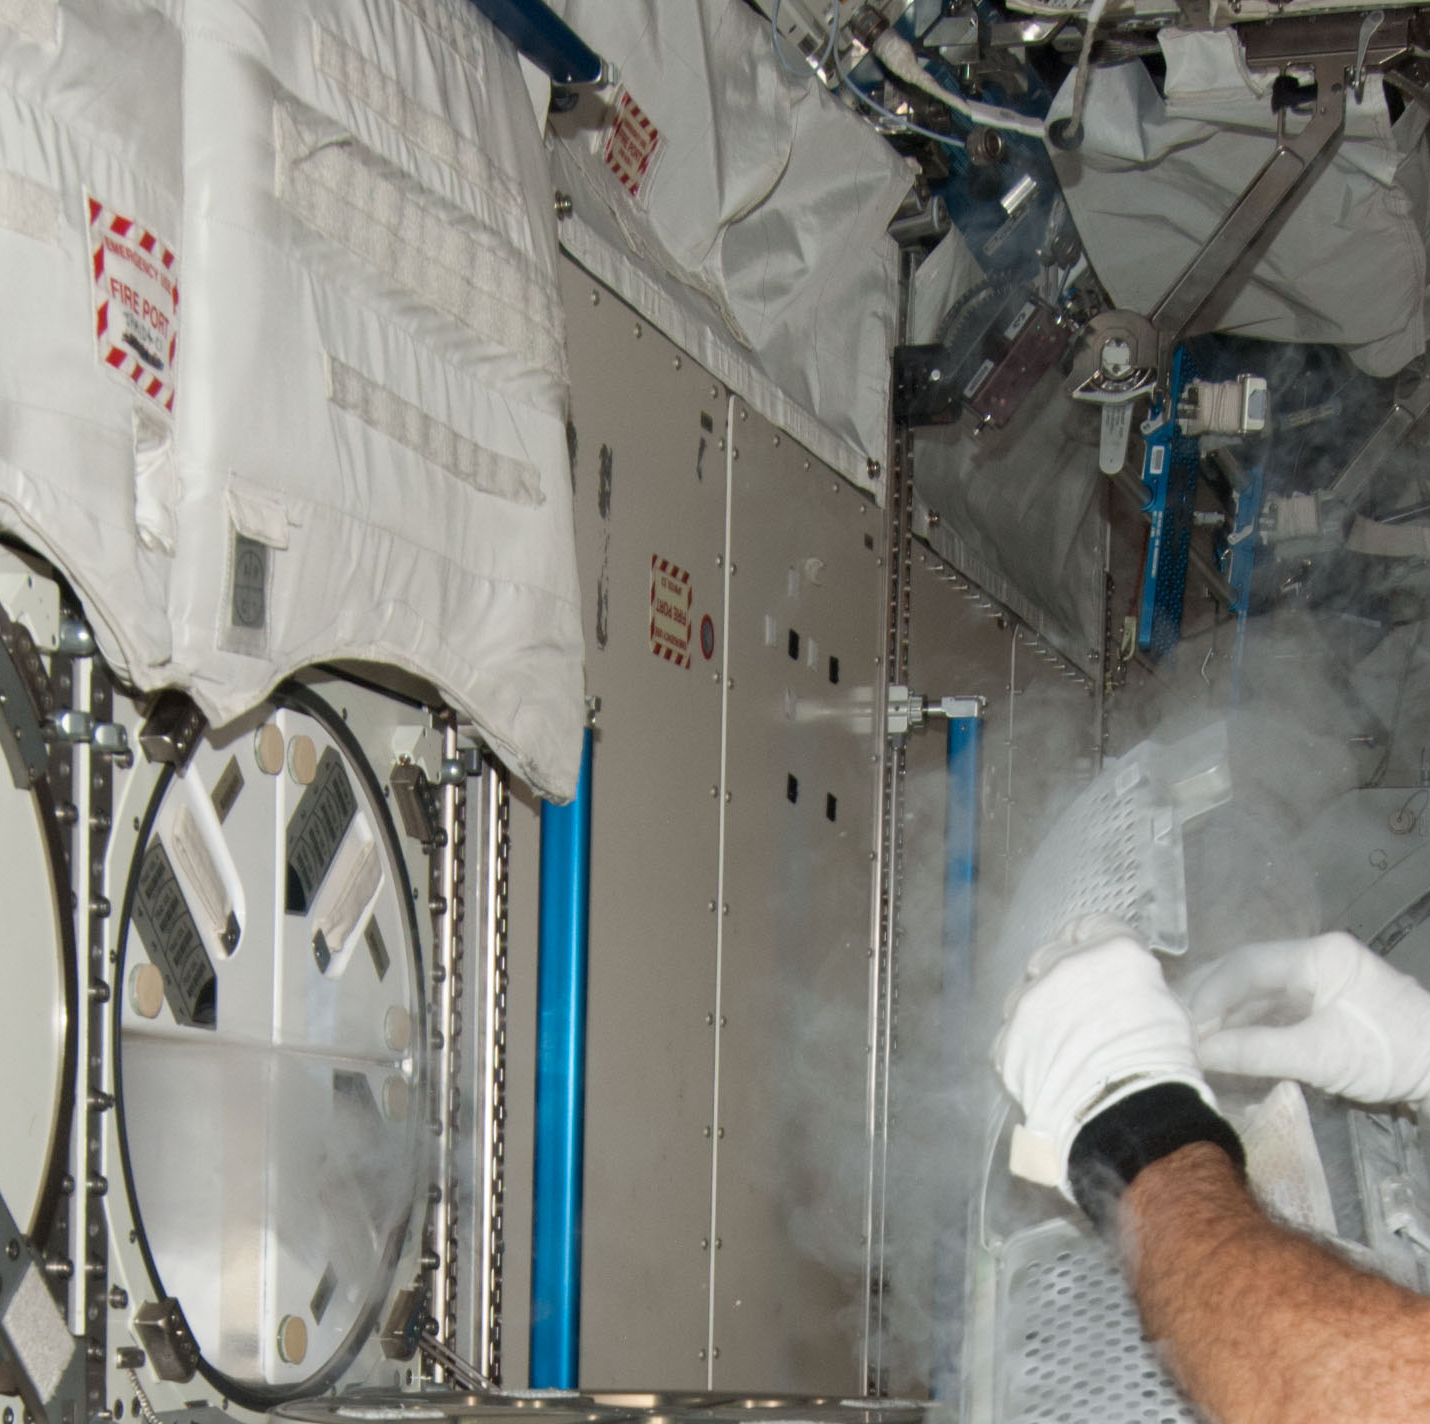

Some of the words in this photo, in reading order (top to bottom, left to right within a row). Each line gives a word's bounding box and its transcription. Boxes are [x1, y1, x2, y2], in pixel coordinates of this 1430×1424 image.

[103, 235, 159, 281] EMERGENCY
[159, 274, 173, 295] USE
[109, 277, 140, 315] FIRE
[141, 298, 171, 337] PORT
[655, 598, 673, 619] PORT
